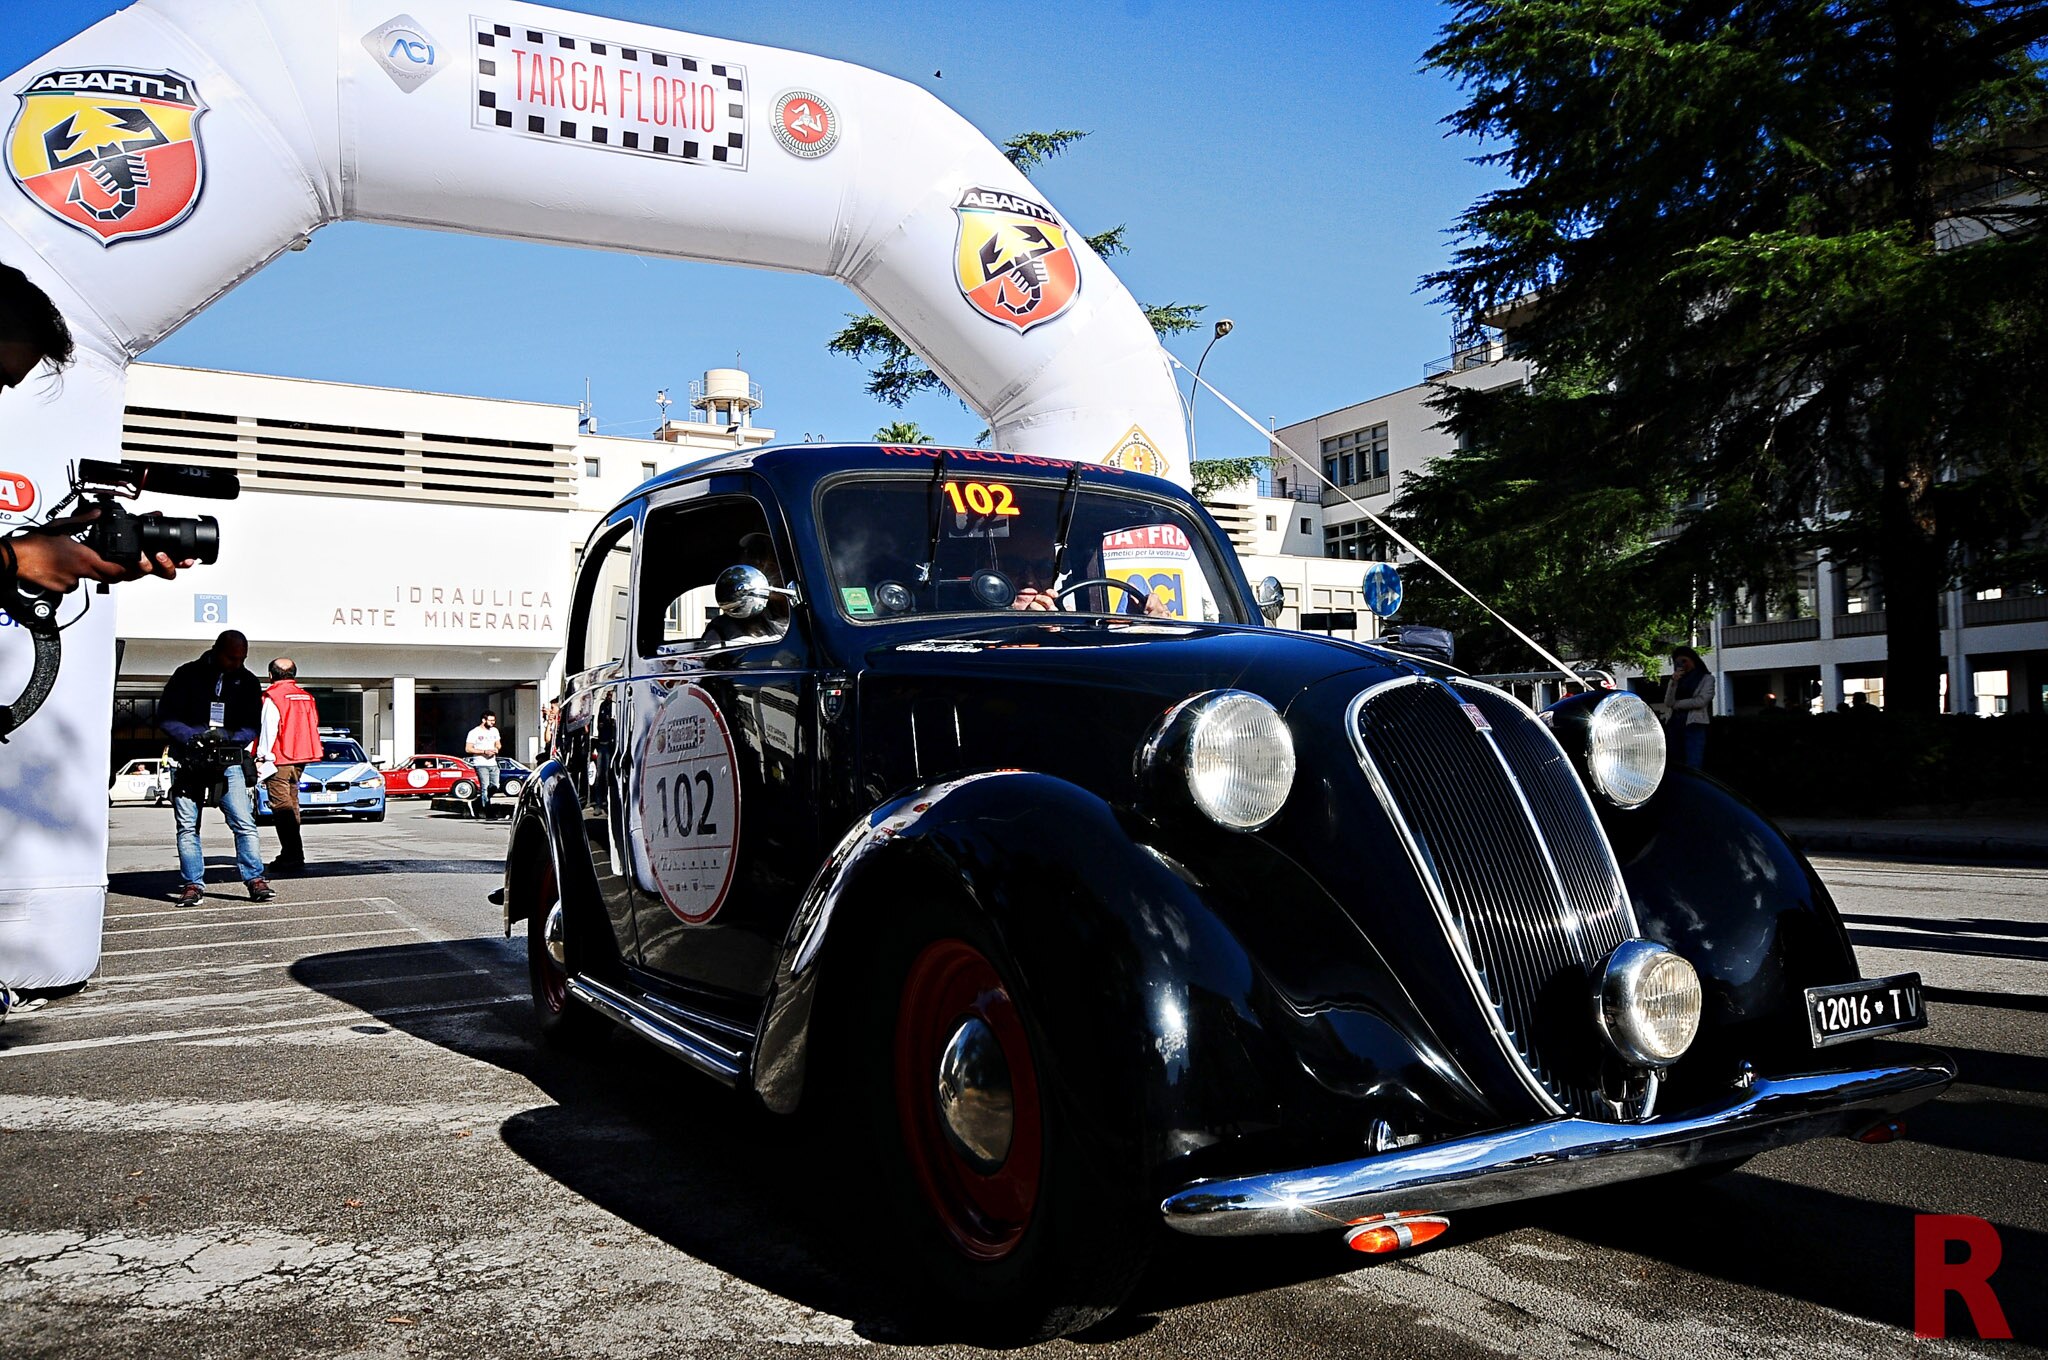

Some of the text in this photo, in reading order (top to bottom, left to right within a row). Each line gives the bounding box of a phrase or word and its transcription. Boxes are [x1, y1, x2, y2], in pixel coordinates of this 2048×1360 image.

[388, 38, 435, 66] ACI
[32, 71, 184, 101] ABARTH
[511, 49, 715, 133] TARGA FLORIO
[772, 125, 801, 156] AUTOMOBILE
[818, 135, 839, 155] PALERMO
[963, 192, 1055, 223] ABARTH
[944, 481, 1021, 516] 102
[1135, 551, 1147, 559] per
[396, 586, 553, 608] IDRAULICA
[202, 602, 220, 623] 8
[332, 607, 553, 631] ARTE MINERARIA
[656, 769, 717, 838] 102
[1817, 994, 1872, 1031] 12016
